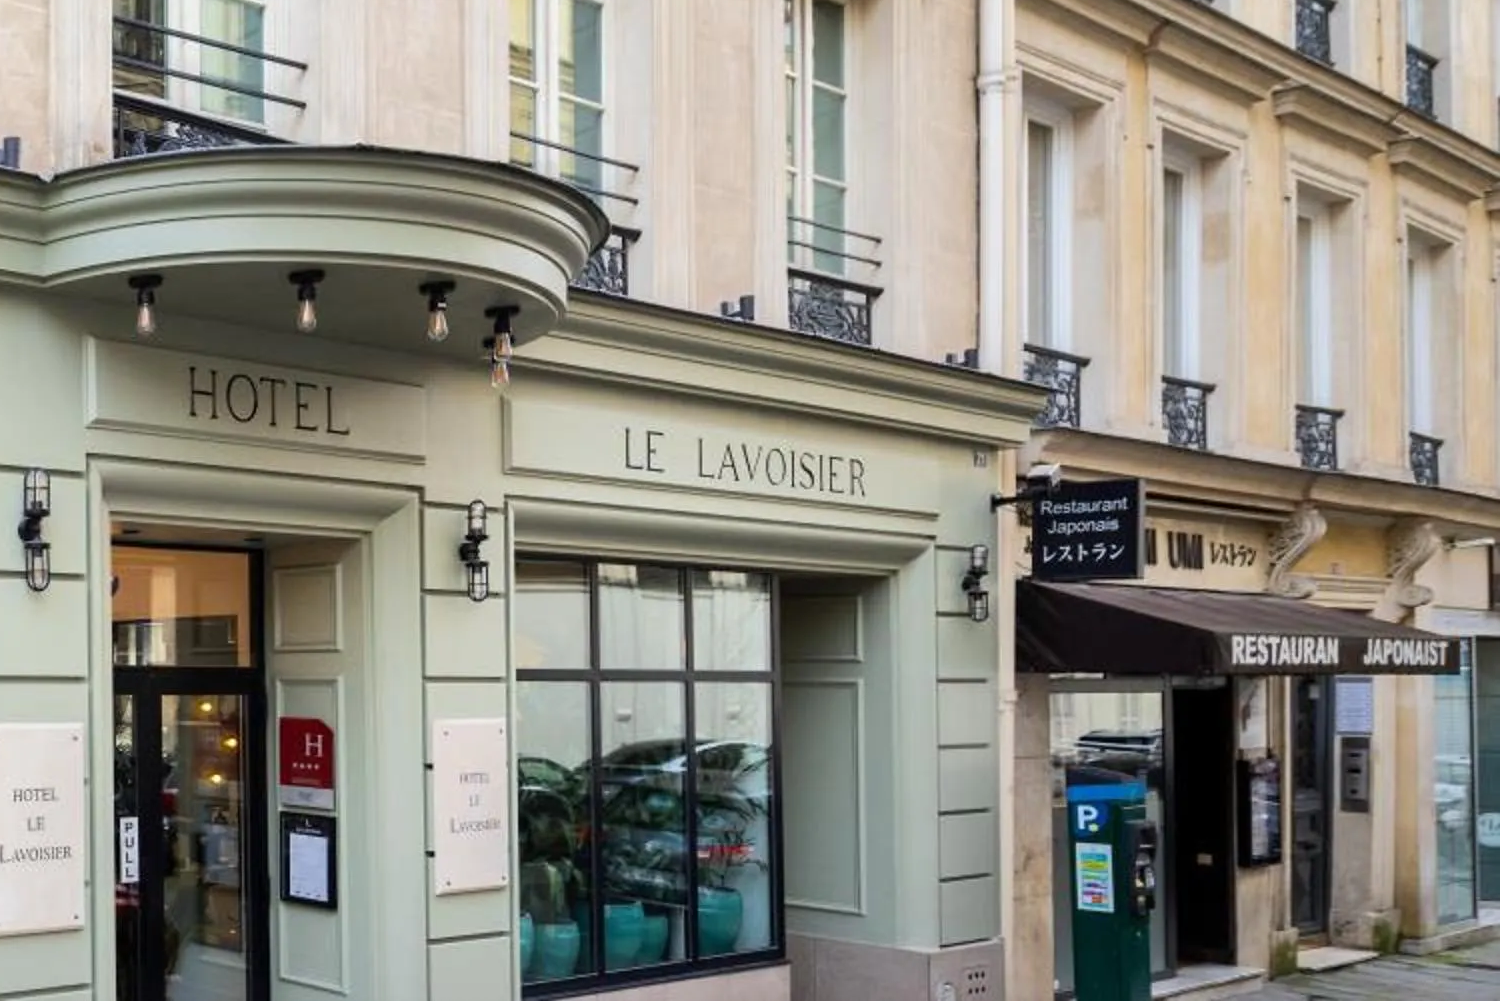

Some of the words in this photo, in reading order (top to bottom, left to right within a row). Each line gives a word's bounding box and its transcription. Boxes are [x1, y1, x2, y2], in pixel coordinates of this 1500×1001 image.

[189, 366, 351, 437] HOTEL
[624, 427, 665, 474] LE
[698, 437, 867, 497] LAVOISIER
[1040, 497, 1128, 515] Restaurant
[1047, 516, 1120, 536] Japonais
[1042, 543, 1125, 564] レストラン
[1231, 635, 1339, 666] RESTAURAN
[1363, 638, 1449, 667] JAPONAIST
[305, 732, 323, 758] H
[13, 787, 60, 803] HOTEL
[27, 816, 45, 832] LE
[1077, 804, 1099, 831] P
[124, 821, 135, 879] PULL
